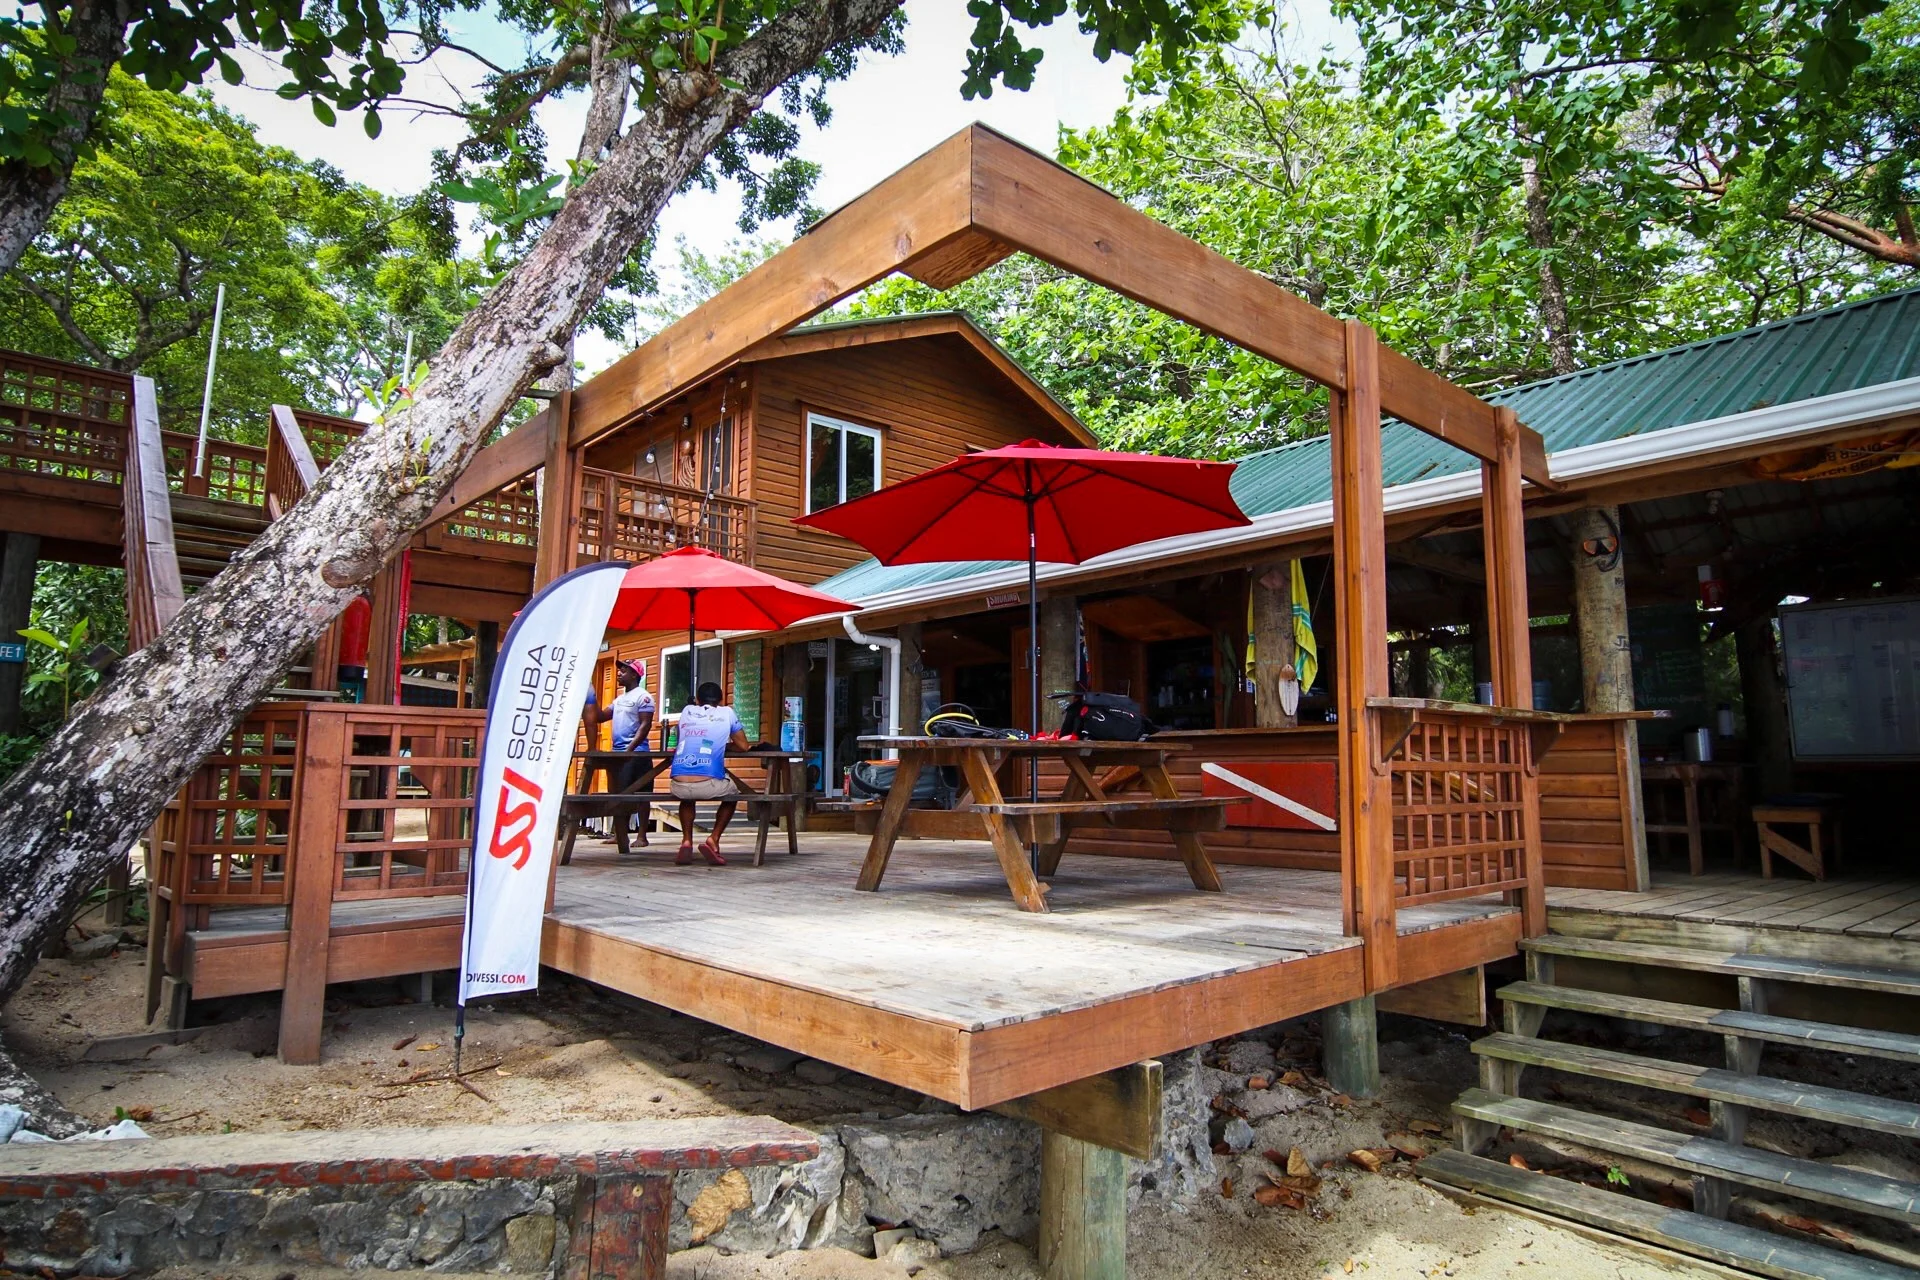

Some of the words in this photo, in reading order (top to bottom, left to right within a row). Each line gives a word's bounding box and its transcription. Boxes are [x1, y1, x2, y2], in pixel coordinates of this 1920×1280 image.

[507, 644, 547, 760] SCUBA
[527, 646, 566, 762] SCHOOLS
[546, 650, 580, 763] INTERNATIONAL
[466, 973, 526, 984] DIVESSI.COM
